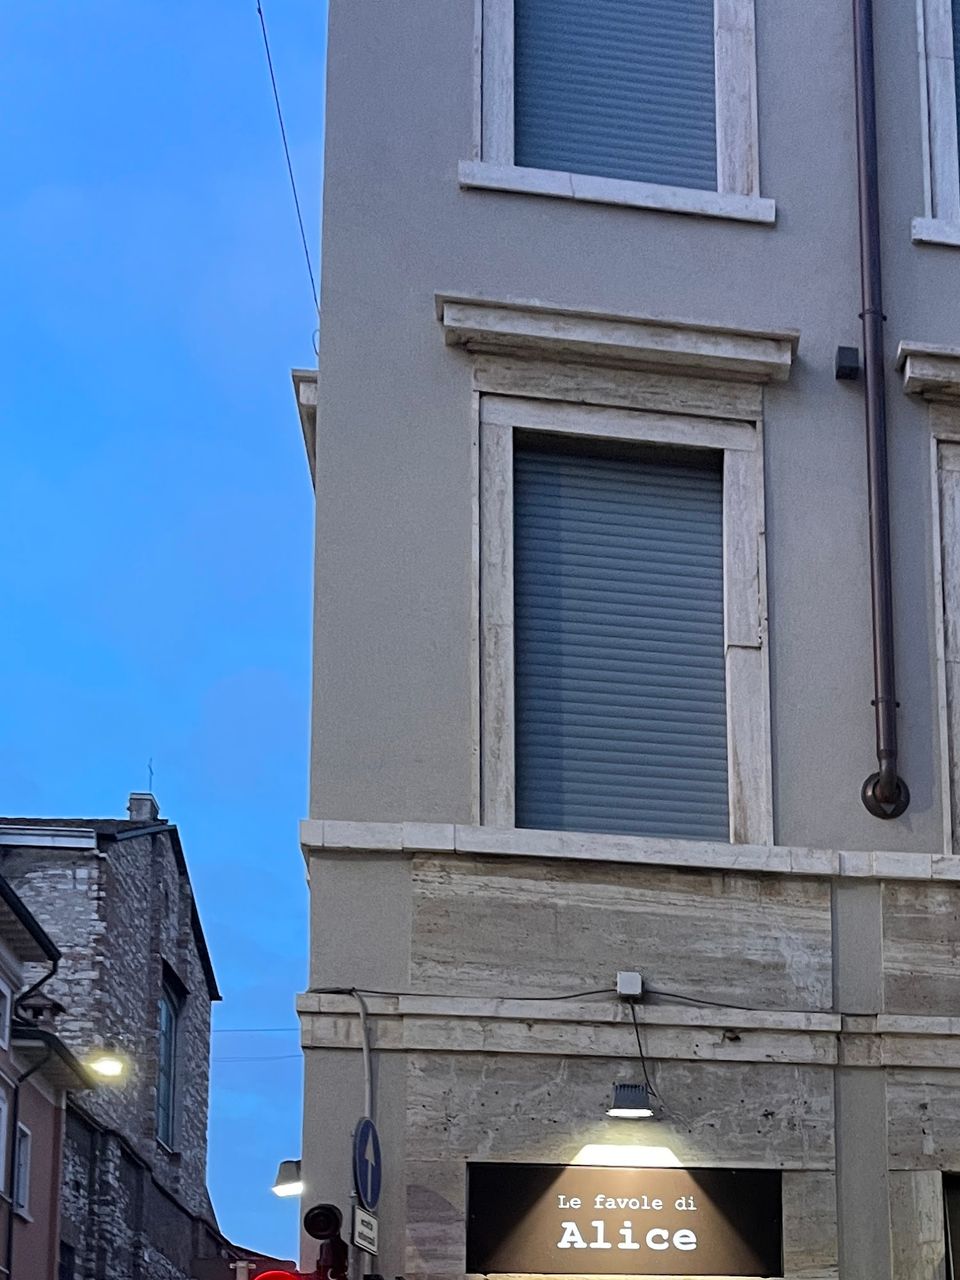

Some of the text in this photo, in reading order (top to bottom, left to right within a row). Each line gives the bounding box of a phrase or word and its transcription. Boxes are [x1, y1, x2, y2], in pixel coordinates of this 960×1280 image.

[557, 1194, 697, 1211] Le favole di
[556, 1220, 697, 1251] Alice
